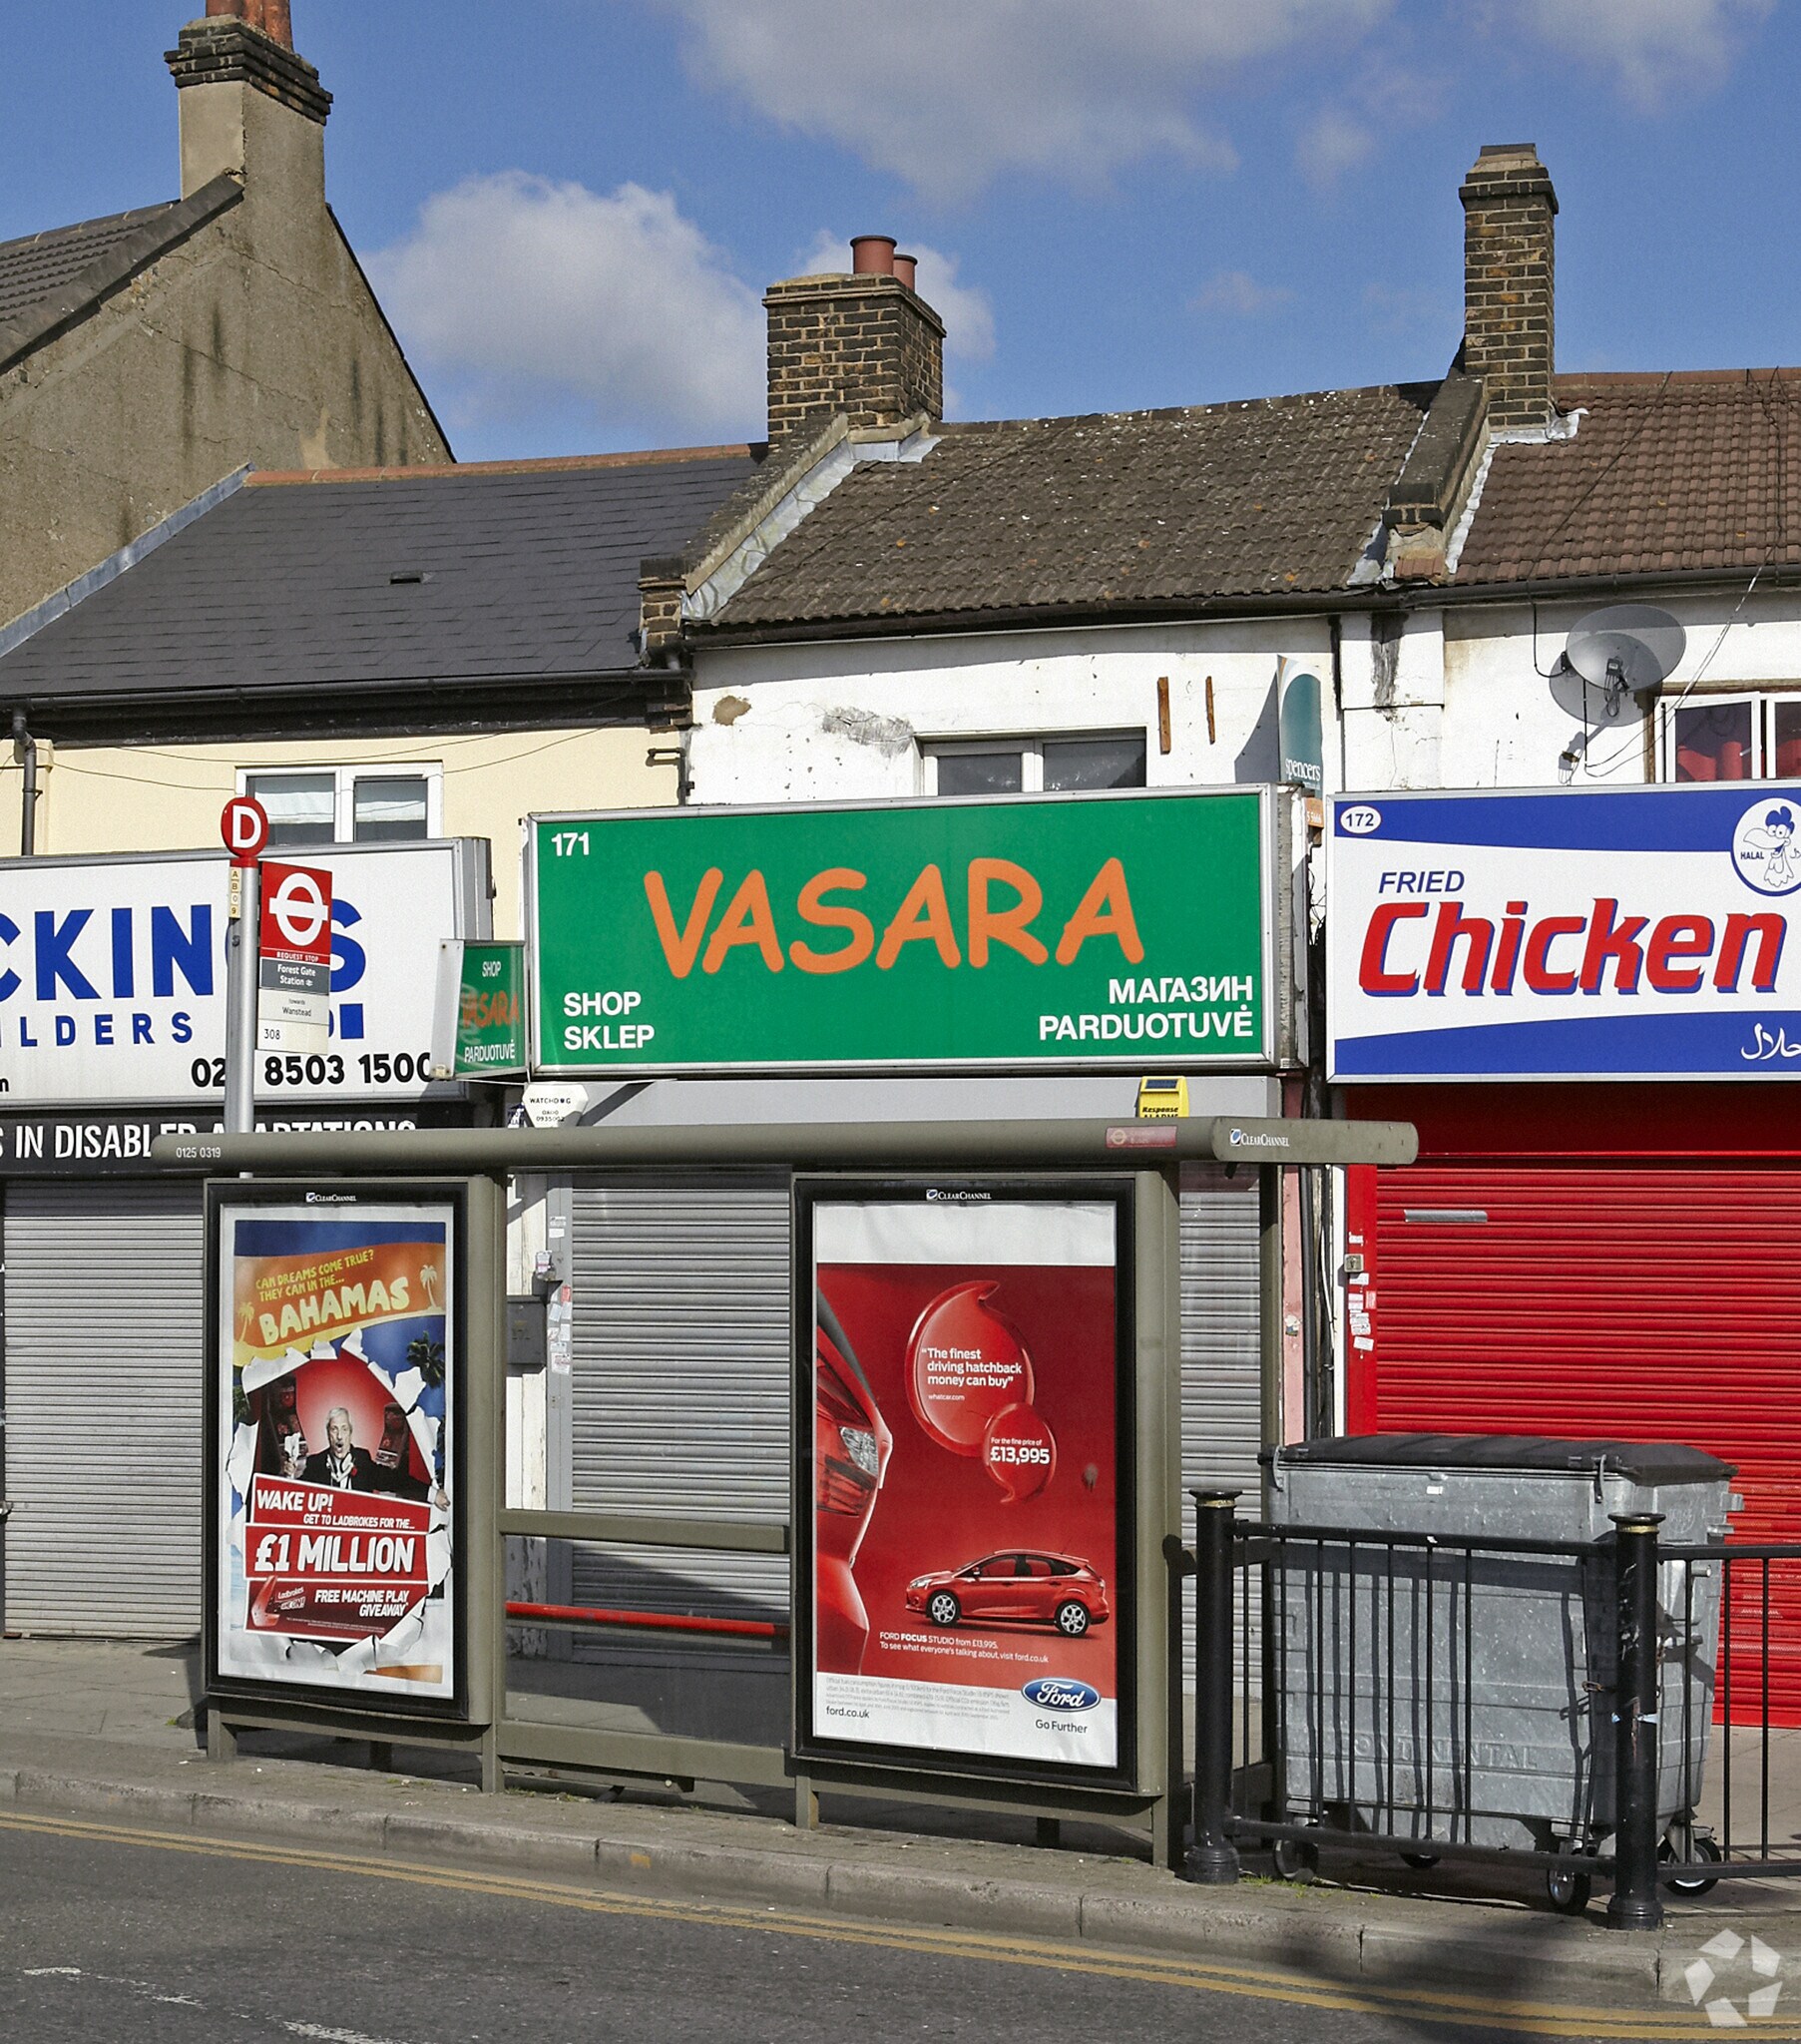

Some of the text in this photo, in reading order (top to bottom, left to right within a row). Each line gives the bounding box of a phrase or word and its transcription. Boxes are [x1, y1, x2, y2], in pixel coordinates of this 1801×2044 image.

[1285, 758, 1322, 781] spencers
[232, 804, 261, 848] D
[1346, 813, 1374, 827] 172
[551, 832, 590, 856] 171
[1378, 871, 1465, 894] FRIED
[644, 857, 1144, 979] VASARA
[276, 951, 303, 960] REQUEST
[1359, 898, 1787, 997] Chicken
[277, 964, 316, 977] Forest Gate
[279, 975, 304, 986] Station
[482, 961, 502, 978] SHOP
[1109, 975, 1253, 1005] МАГАЗИН
[282, 1006, 311, 1017] Wanstead
[462, 990, 520, 1029] VASARA
[564, 992, 642, 1017] SHOP
[0, 1012, 193, 1047] LDERS
[1039, 1002, 1253, 1041] PARDUOTUVĖ
[263, 1029, 280, 1040] 308
[564, 1025, 655, 1050] SKLEP
[464, 1039, 515, 1063] PARDUOTUVĖ
[264, 1054, 344, 1086] 8503
[16, 1126, 44, 1159] IN
[176, 1147, 222, 1158] 0125 0319
[255, 1250, 374, 1289] CAN DREAMS COME TRUE?
[259, 1274, 345, 1302] THEY CAN IN THE...
[259, 1277, 410, 1346] BAHAMAS
[949, 1348, 981, 1359] finest
[927, 1361, 1022, 1374] driving hatchback
[927, 1375, 964, 1387] money
[966, 1376, 986, 1386] can
[1022, 1438, 1035, 1447] price
[990, 1446, 1051, 1465] £13,995
[256, 1489, 333, 1513] WAKE UP!
[303, 1513, 318, 1525] GET
[321, 1514, 331, 1525] TO
[332, 1515, 378, 1528] LADBROKES
[379, 1517, 394, 1528] FOR
[254, 1533, 415, 1573] £1 MILLION
[314, 1589, 409, 1603] FREE MACHINE PLAY
[879, 1631, 900, 1641] FORD
[900, 1633, 928, 1643] FOCUS
[928, 1635, 955, 1646] STUDIO
[955, 1638, 971, 1647] from
[879, 1641, 889, 1650] To
[902, 1643, 920, 1652] what
[955, 1648, 978, 1659] talking
[1000, 1652, 1014, 1661] visit
[1015, 1653, 1049, 1664] ford.co.uk
[1036, 1681, 1086, 1708] Ford
[826, 1706, 870, 1719] ford.co.uk
[1035, 1719, 1089, 1734] Go Further
